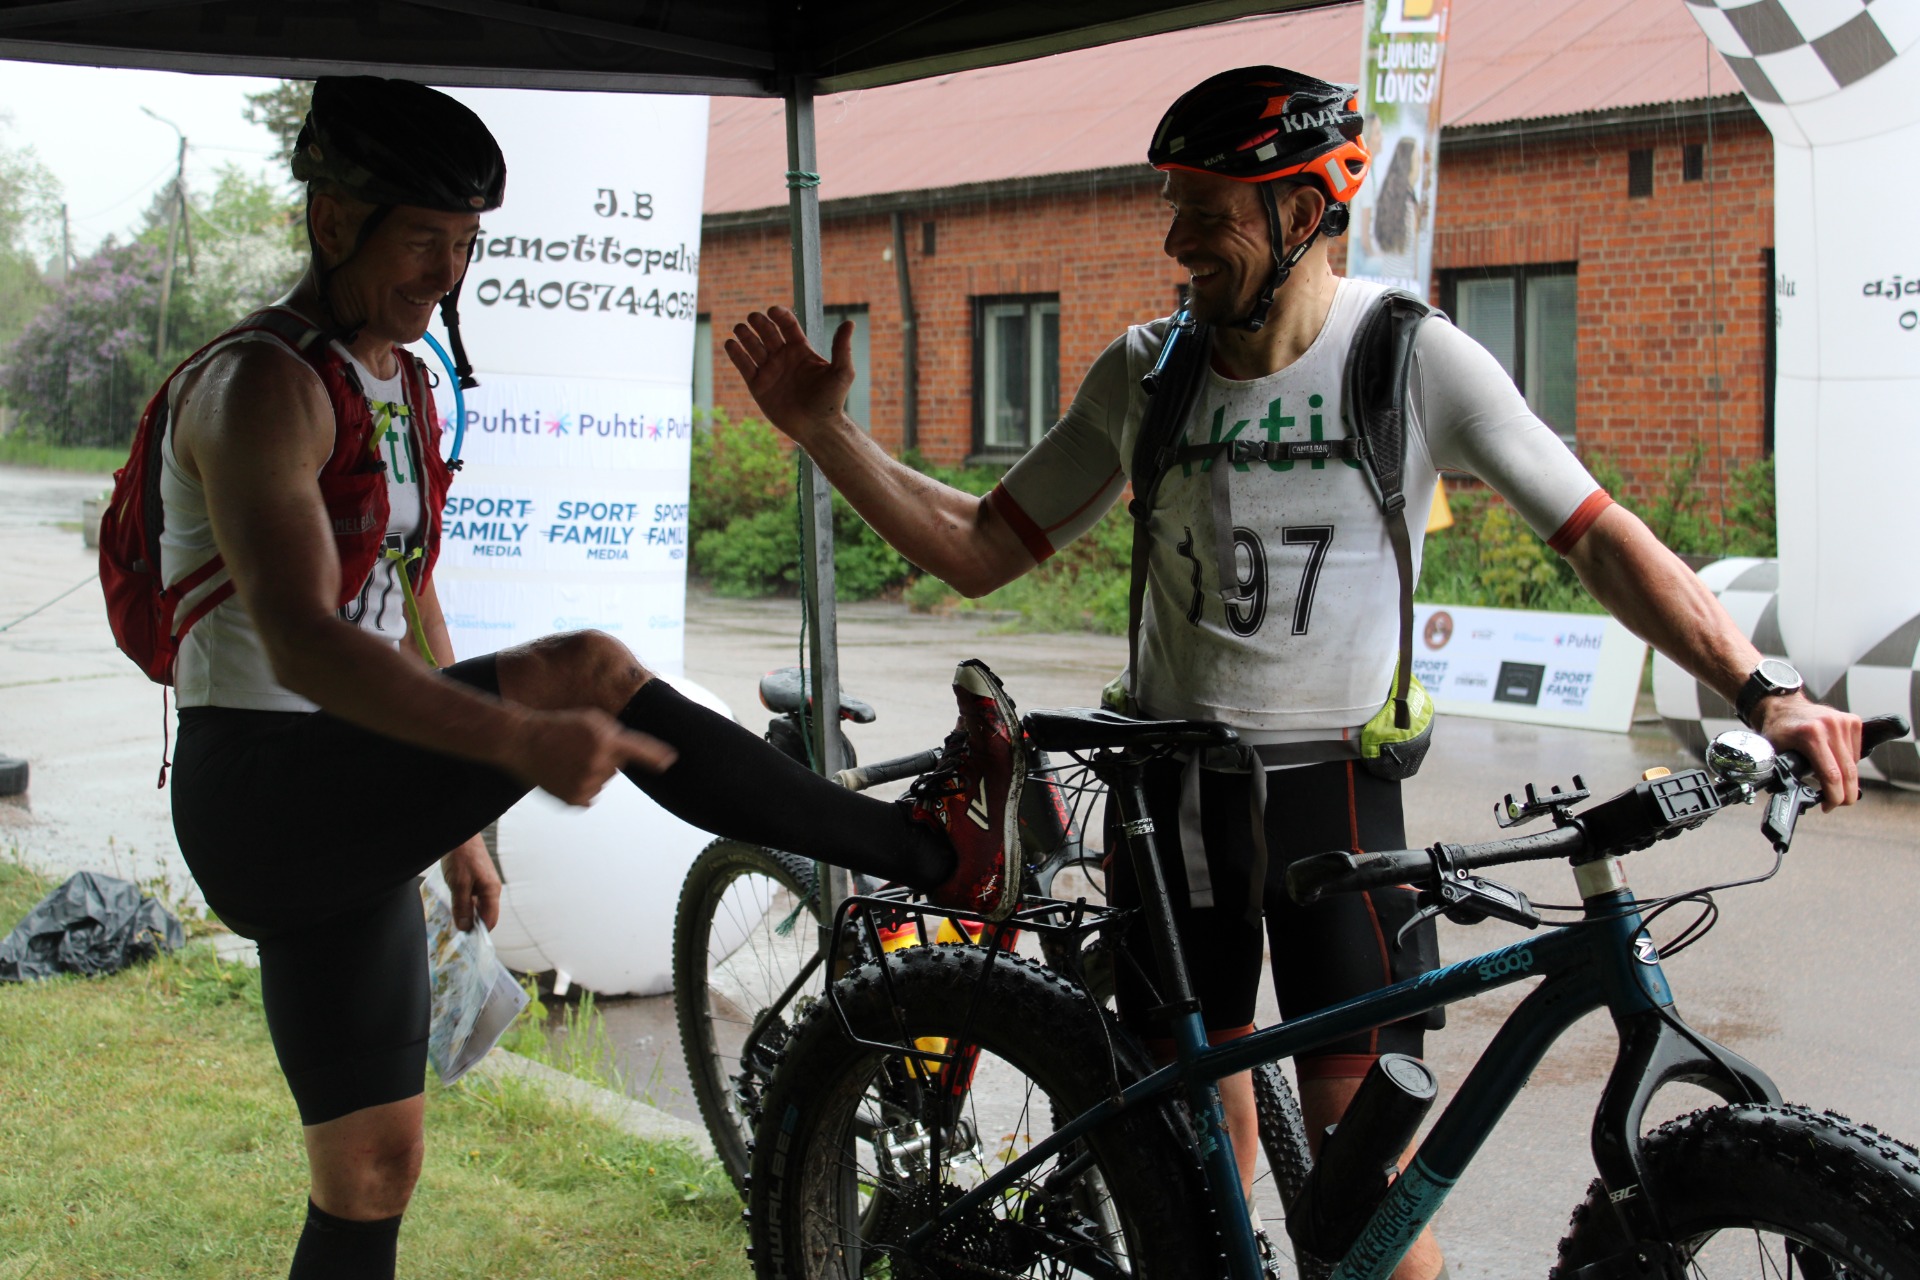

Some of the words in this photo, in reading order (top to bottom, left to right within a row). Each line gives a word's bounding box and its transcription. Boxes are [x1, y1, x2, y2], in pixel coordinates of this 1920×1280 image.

[593, 188, 655, 221] J.B
[464, 409, 540, 435] Puhti
[579, 413, 645, 439] Puhti
[334, 508, 377, 533] MELBAK
[443, 497, 533, 518] SPORT
[557, 501, 638, 522] SPORT
[548, 524, 634, 546] FAMILY
[472, 544, 522, 557] MEDIA
[586, 548, 629, 560] MEDIA
[1566, 632, 1603, 650] Puhti
[1413, 659, 1449, 672] SPORT
[1553, 670, 1592, 684] SPORT
[1548, 683, 1590, 698] FAMILY
